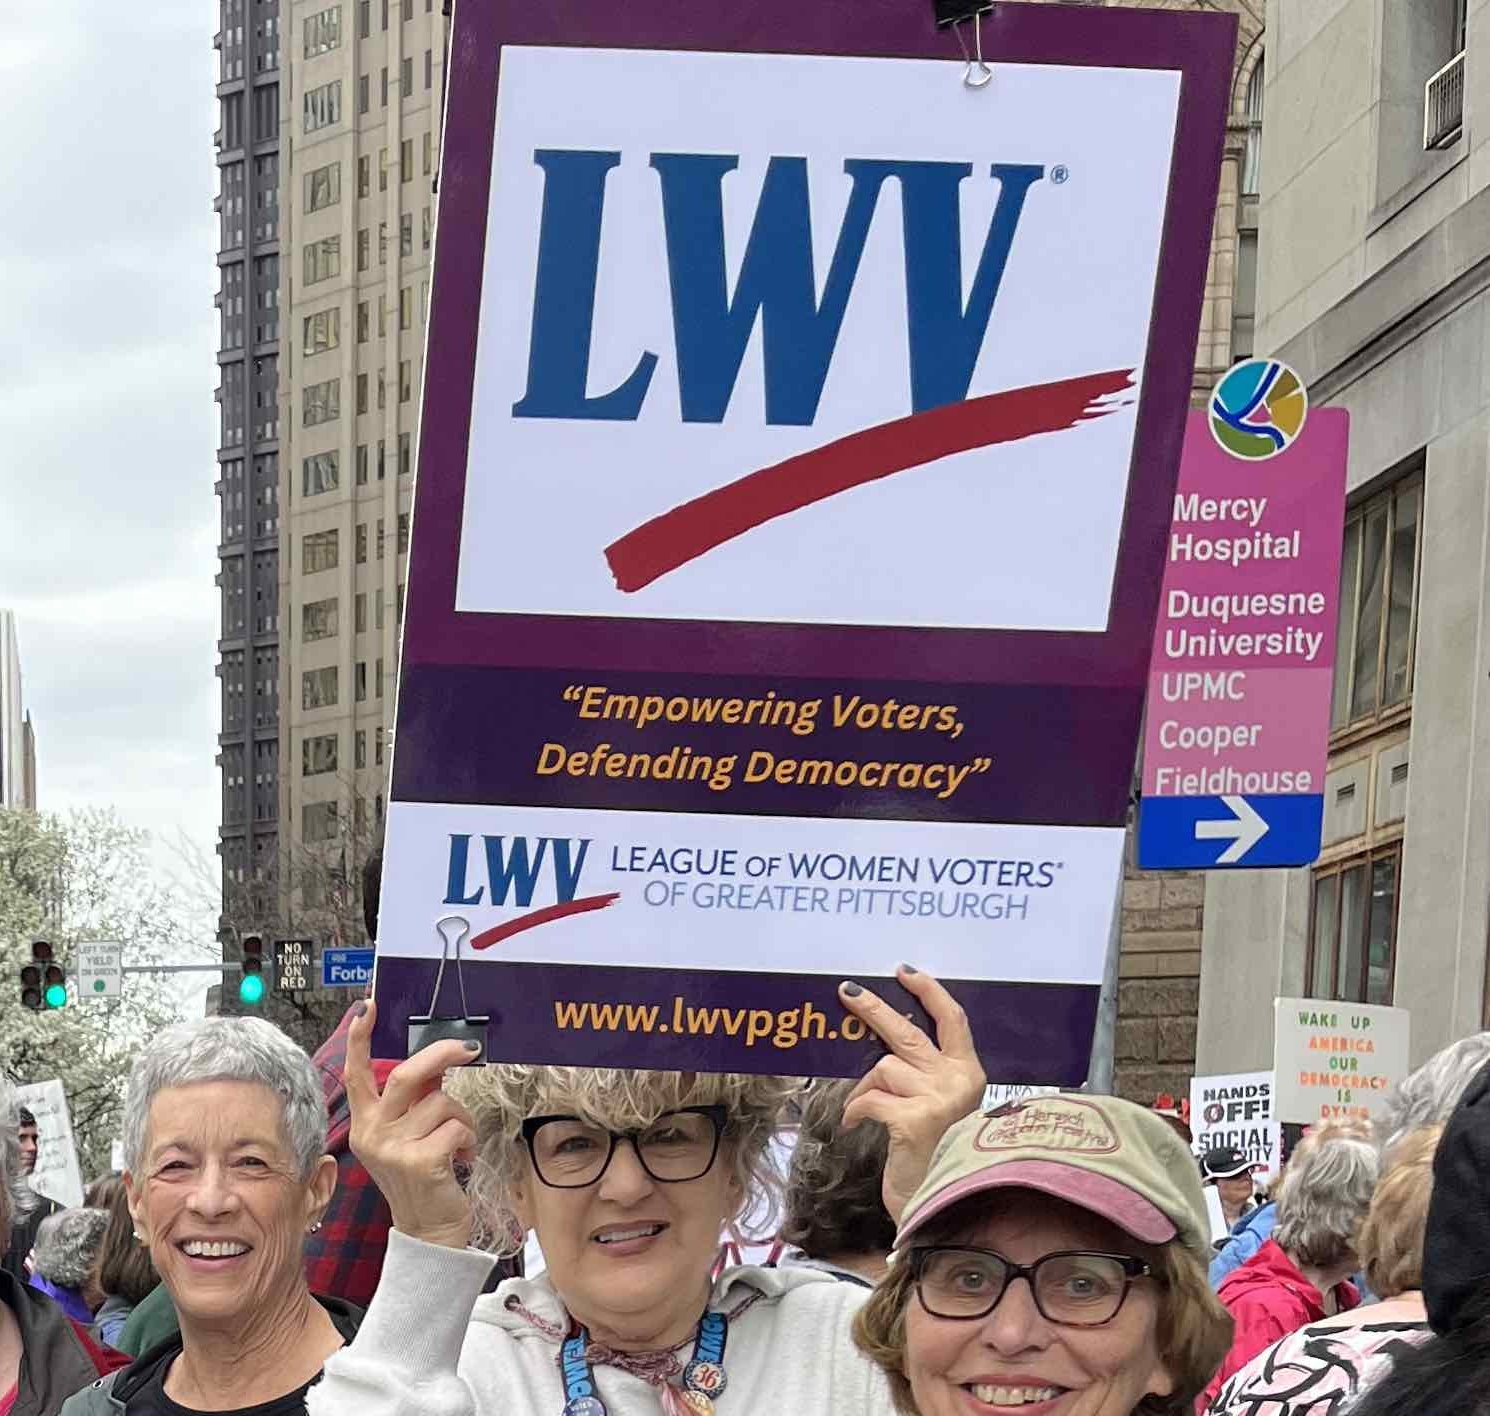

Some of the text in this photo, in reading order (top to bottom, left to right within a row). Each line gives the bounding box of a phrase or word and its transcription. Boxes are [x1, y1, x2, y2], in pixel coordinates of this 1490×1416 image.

[1171, 493, 1267, 527] Mercy
[1169, 530, 1299, 566] Hospital
[1167, 589, 1326, 624] Duquesne
[1164, 627, 1324, 661] University
[1161, 671, 1246, 702] UPMC
[832, 695, 964, 739] Voters,
[1159, 720, 1262, 755] Cooper
[536, 743, 738, 791] Defending
[1155, 766, 1312, 796] Fieldhouse
[443, 834, 593, 907] LWV
[611, 846, 738, 875] LEAGUE
[788, 852, 920, 883] WOMEN
[644, 880, 1029, 920] OF GREATER PITTSBURGH
[277, 954, 310, 966] TURN
[285, 943, 302, 954] NO
[280, 977, 306, 989] RED
[285, 966, 302, 977] ON
[554, 997, 878, 1048] www.lwvpgh.o
[1298, 1011, 1371, 1030] WAKE UP
[1308, 1036, 1374, 1053] AMERICA
[1329, 1056, 1358, 1071] OUR
[1203, 1083, 1270, 1101] HANDS
[1300, 1071, 1387, 1089] DEMOCRACY
[1203, 1099, 1270, 1123] OFF!
[1337, 1089, 1351, 1103] IS
[1198, 1128, 1273, 1152] SOCIAL
